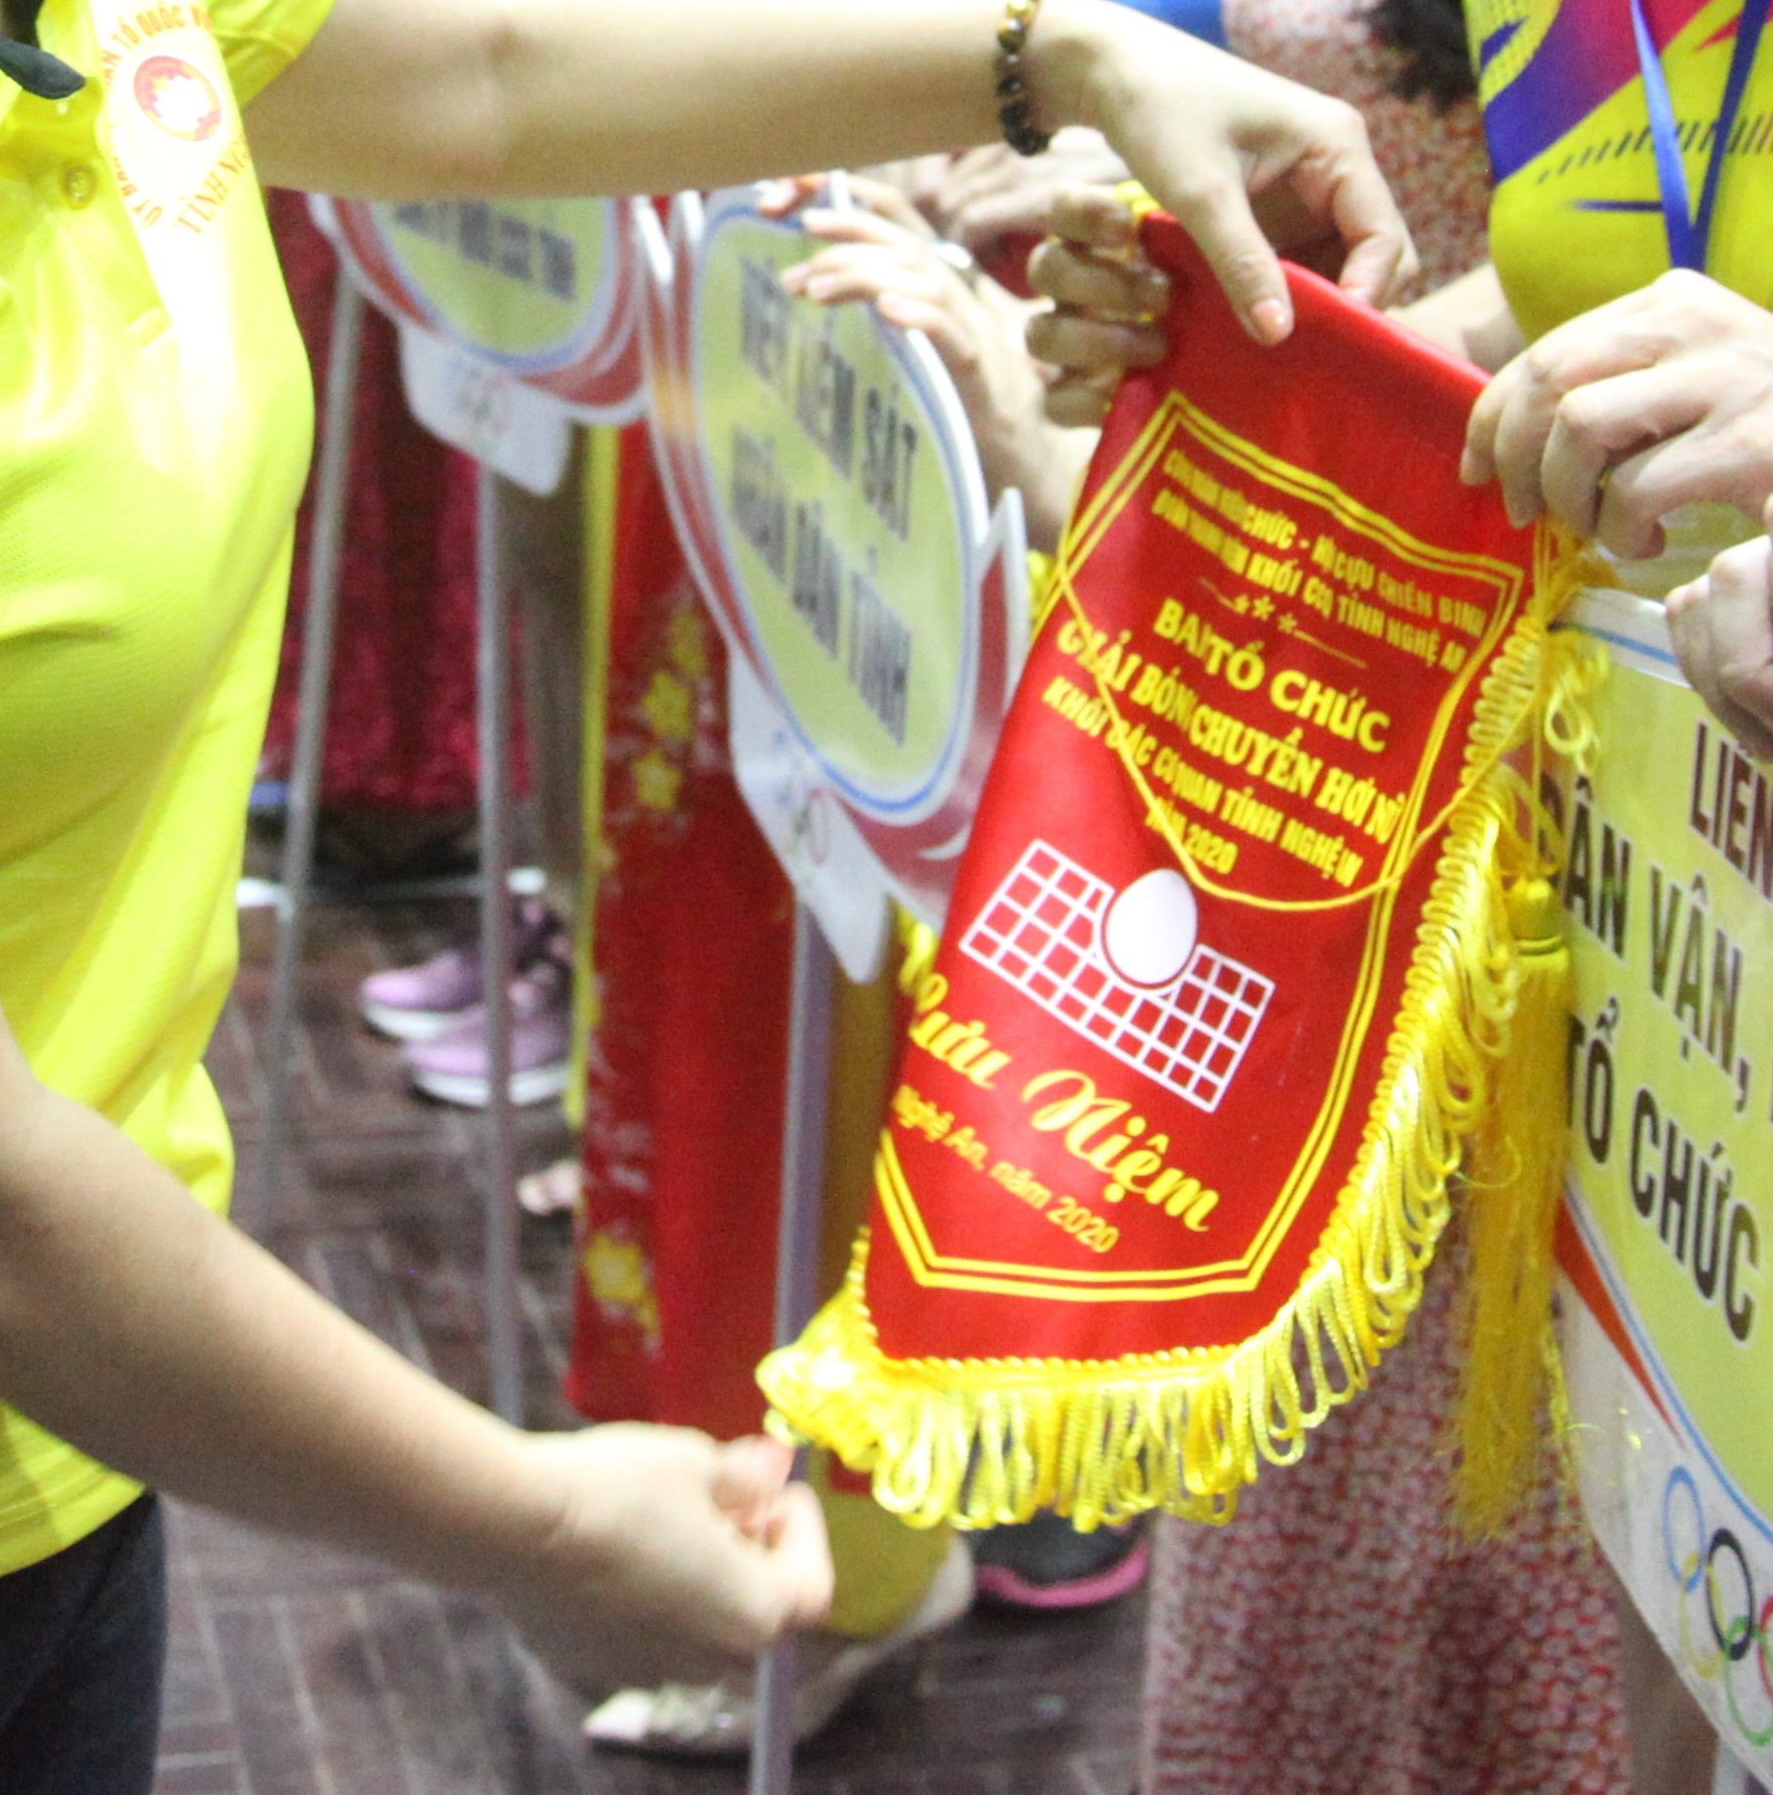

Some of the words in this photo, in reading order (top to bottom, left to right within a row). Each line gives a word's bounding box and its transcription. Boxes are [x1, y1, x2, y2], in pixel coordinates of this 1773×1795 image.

[1203, 638, 1266, 691] TỔ
[1269, 668, 1392, 753] CHỨC
[1042, 675, 1111, 738] KHỐI
[1219, 787, 1284, 843] TỈNH
[1279, 818, 1345, 880] NGHỆ
[1185, 823, 1239, 875] 2020
[1650, 871, 1750, 1114] VẬN,
[988, 1161, 1052, 1209] năm
[1046, 1195, 1120, 1253] 2020
[1021, 1069, 1220, 1232] Niệm
[1629, 1086, 1761, 1345] CHỨC
